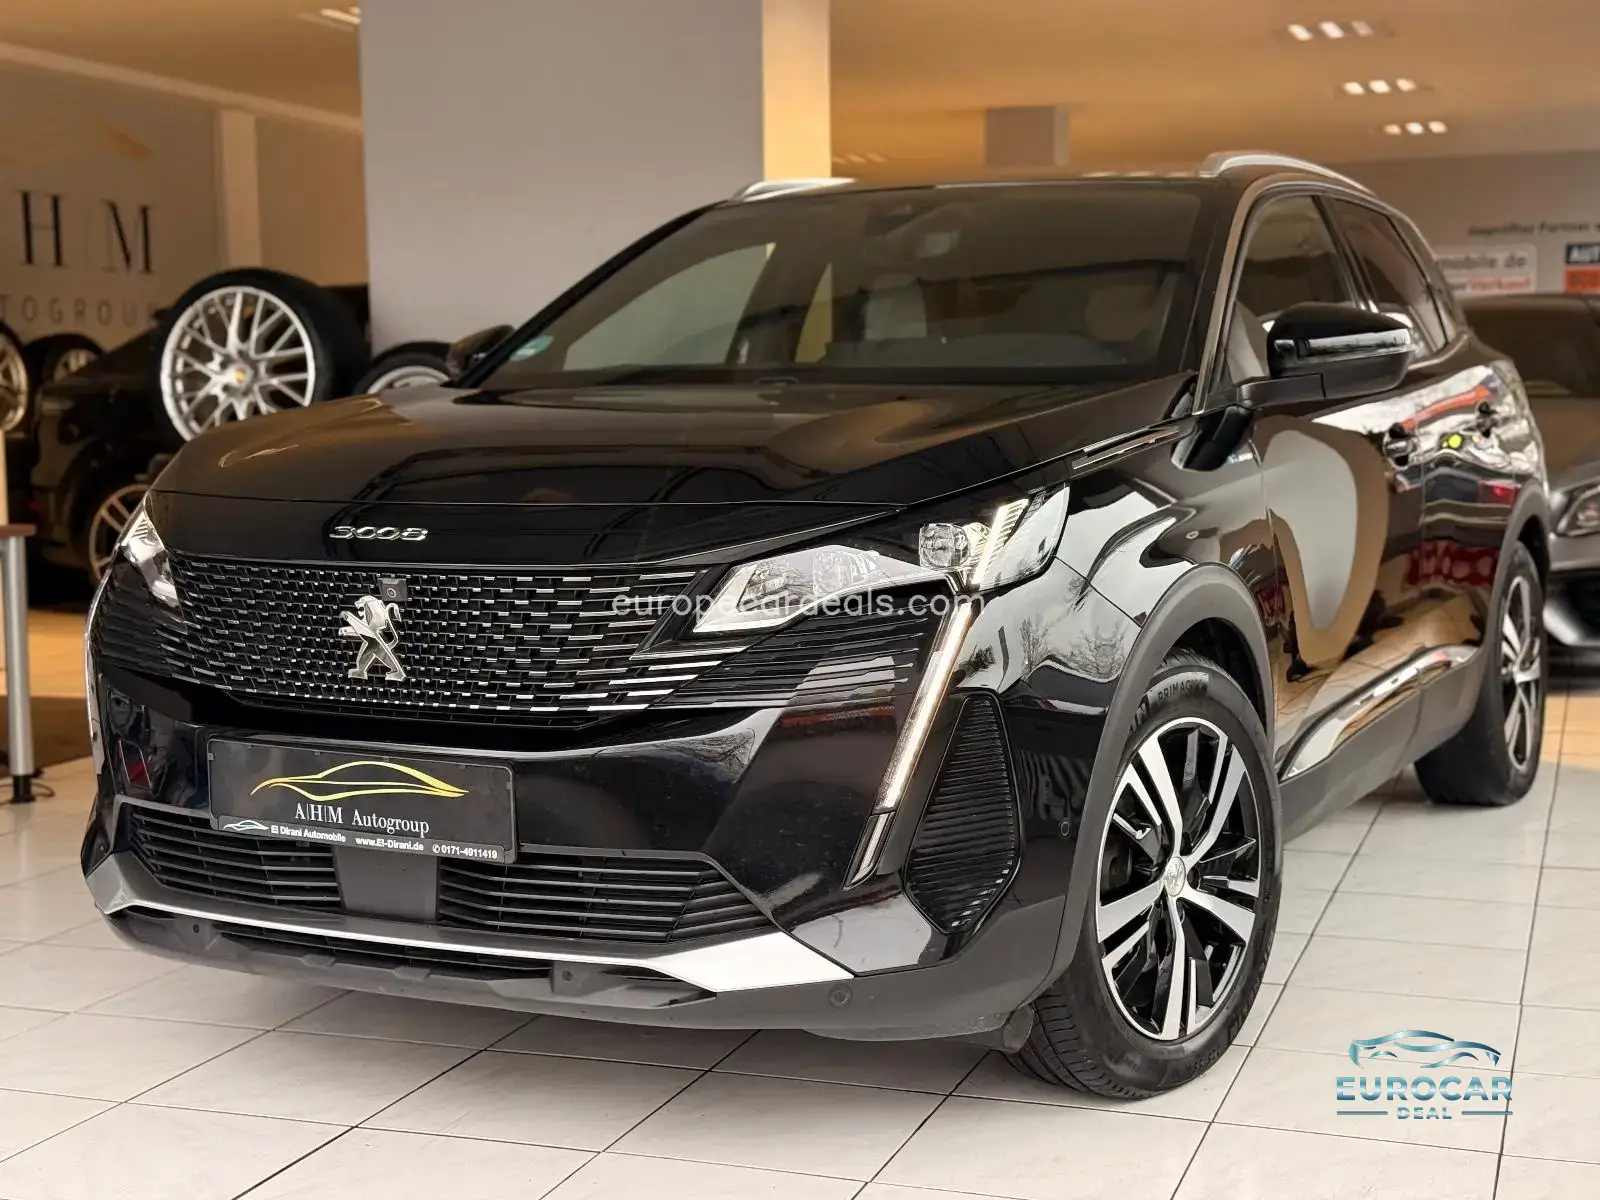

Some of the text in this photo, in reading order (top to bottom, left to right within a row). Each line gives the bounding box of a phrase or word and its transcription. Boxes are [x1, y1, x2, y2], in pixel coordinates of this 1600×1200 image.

[329, 526, 429, 541] 3008
[352, 808, 429, 838] Autogroup
[280, 826, 303, 837] Dirani
[303, 828, 346, 843] Automobile
[355, 836, 424, 851] www.El-Dirani.de
